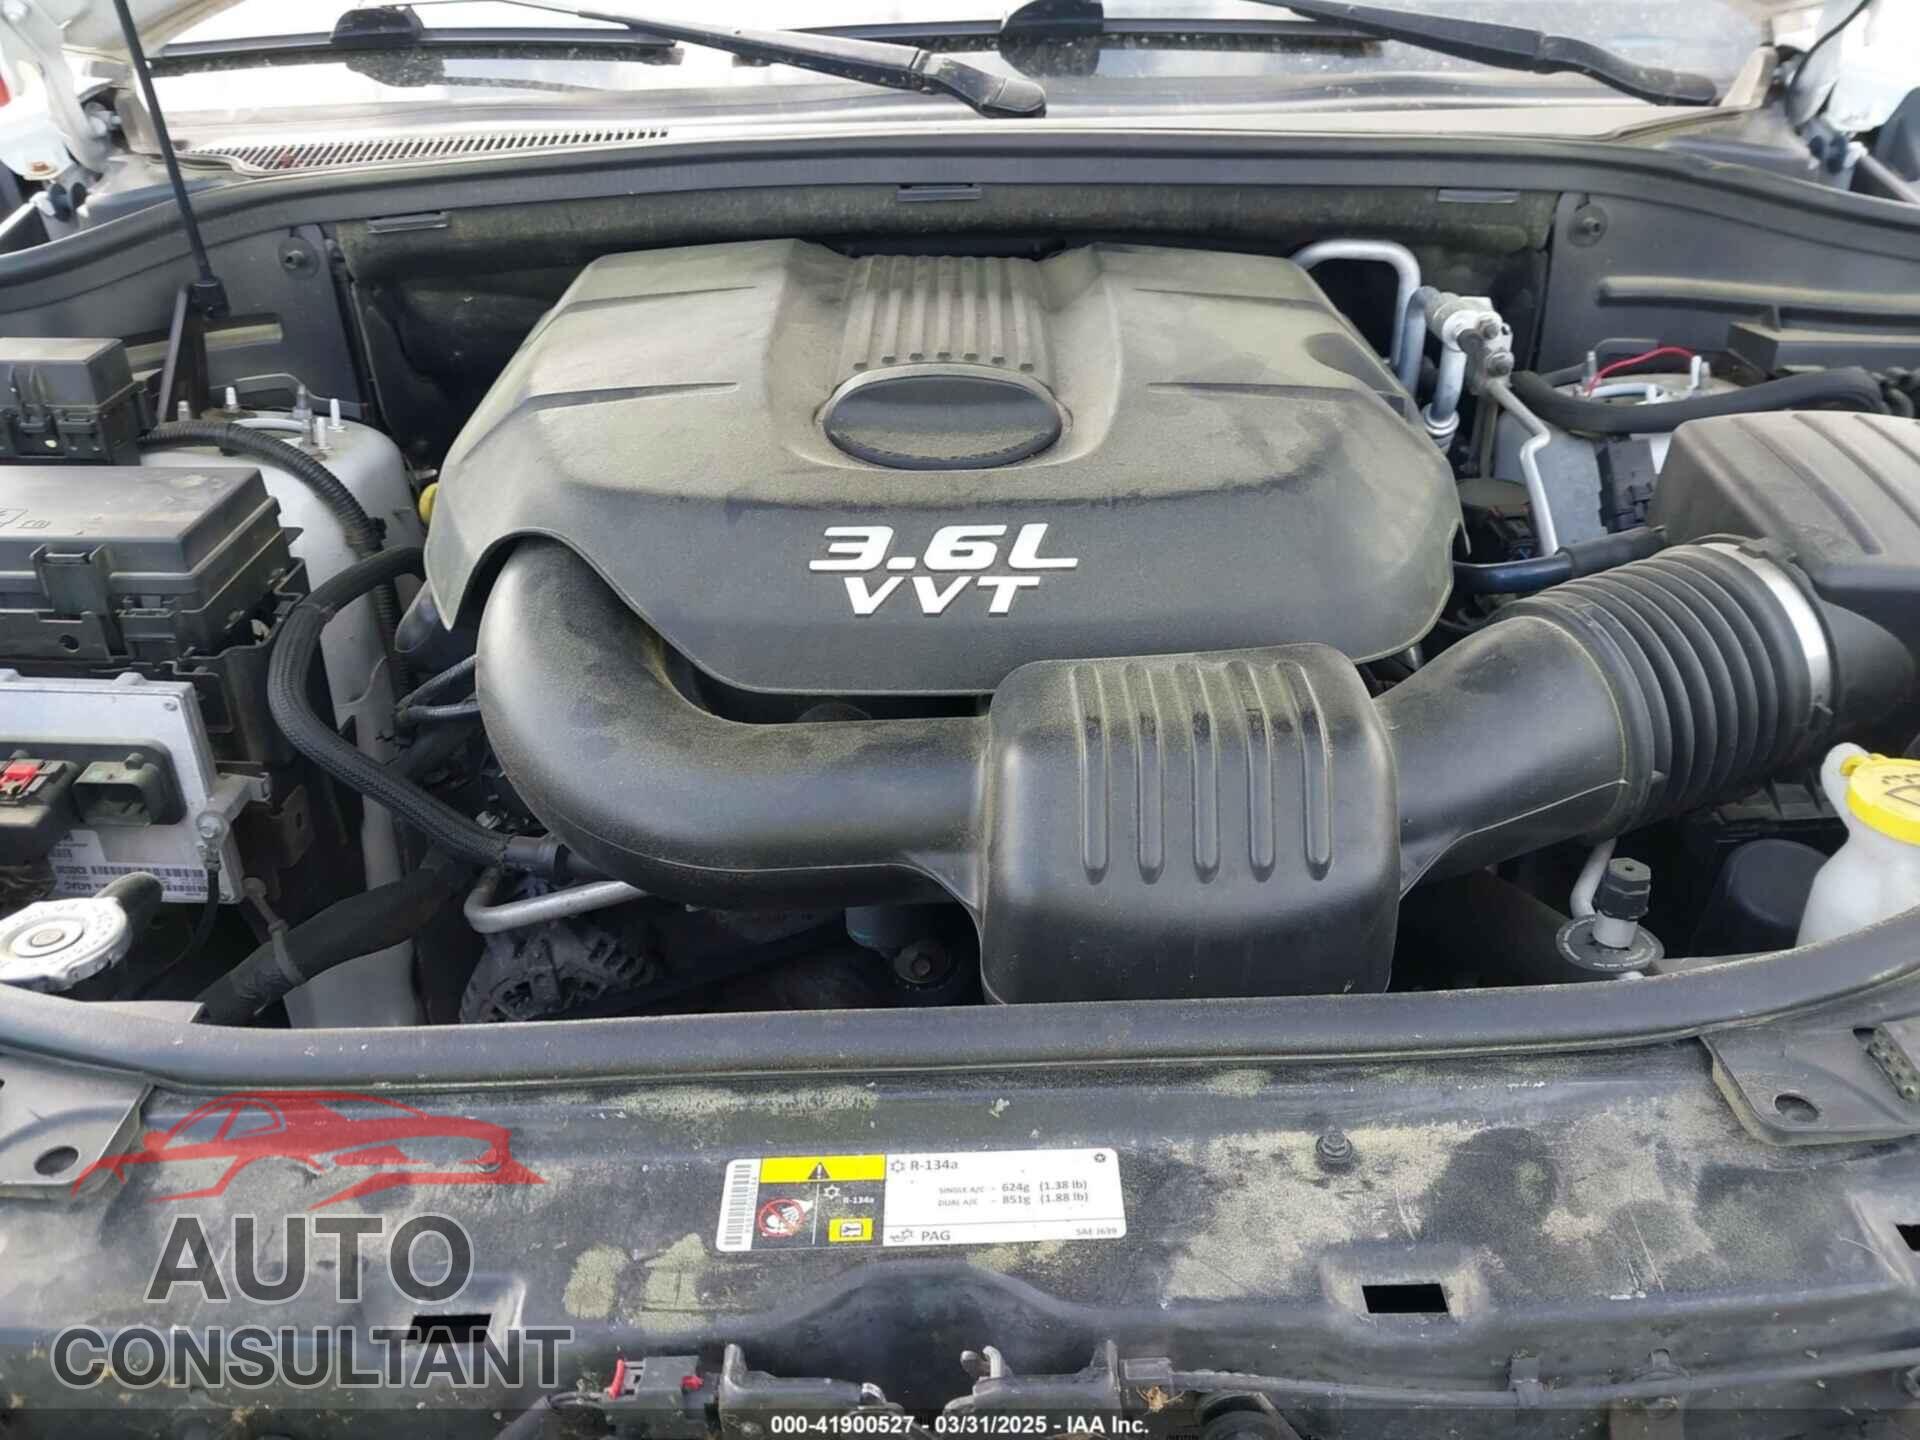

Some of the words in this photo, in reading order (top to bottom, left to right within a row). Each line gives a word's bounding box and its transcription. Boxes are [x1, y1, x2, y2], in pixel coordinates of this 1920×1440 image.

[809, 523, 1079, 571] 3.6L
[843, 576, 1041, 616] VVT
[909, 1159, 959, 1172] R-134a
[1001, 1182, 1030, 1194] 624g
[1039, 1180, 1069, 1192] (1.38
[1072, 1179, 1087, 1190] lb)
[1002, 1194, 1031, 1206] 851g
[1040, 1192, 1070, 1204] (1.88
[1073, 1191, 1089, 1203] lb)
[921, 1229, 951, 1242] PAG
